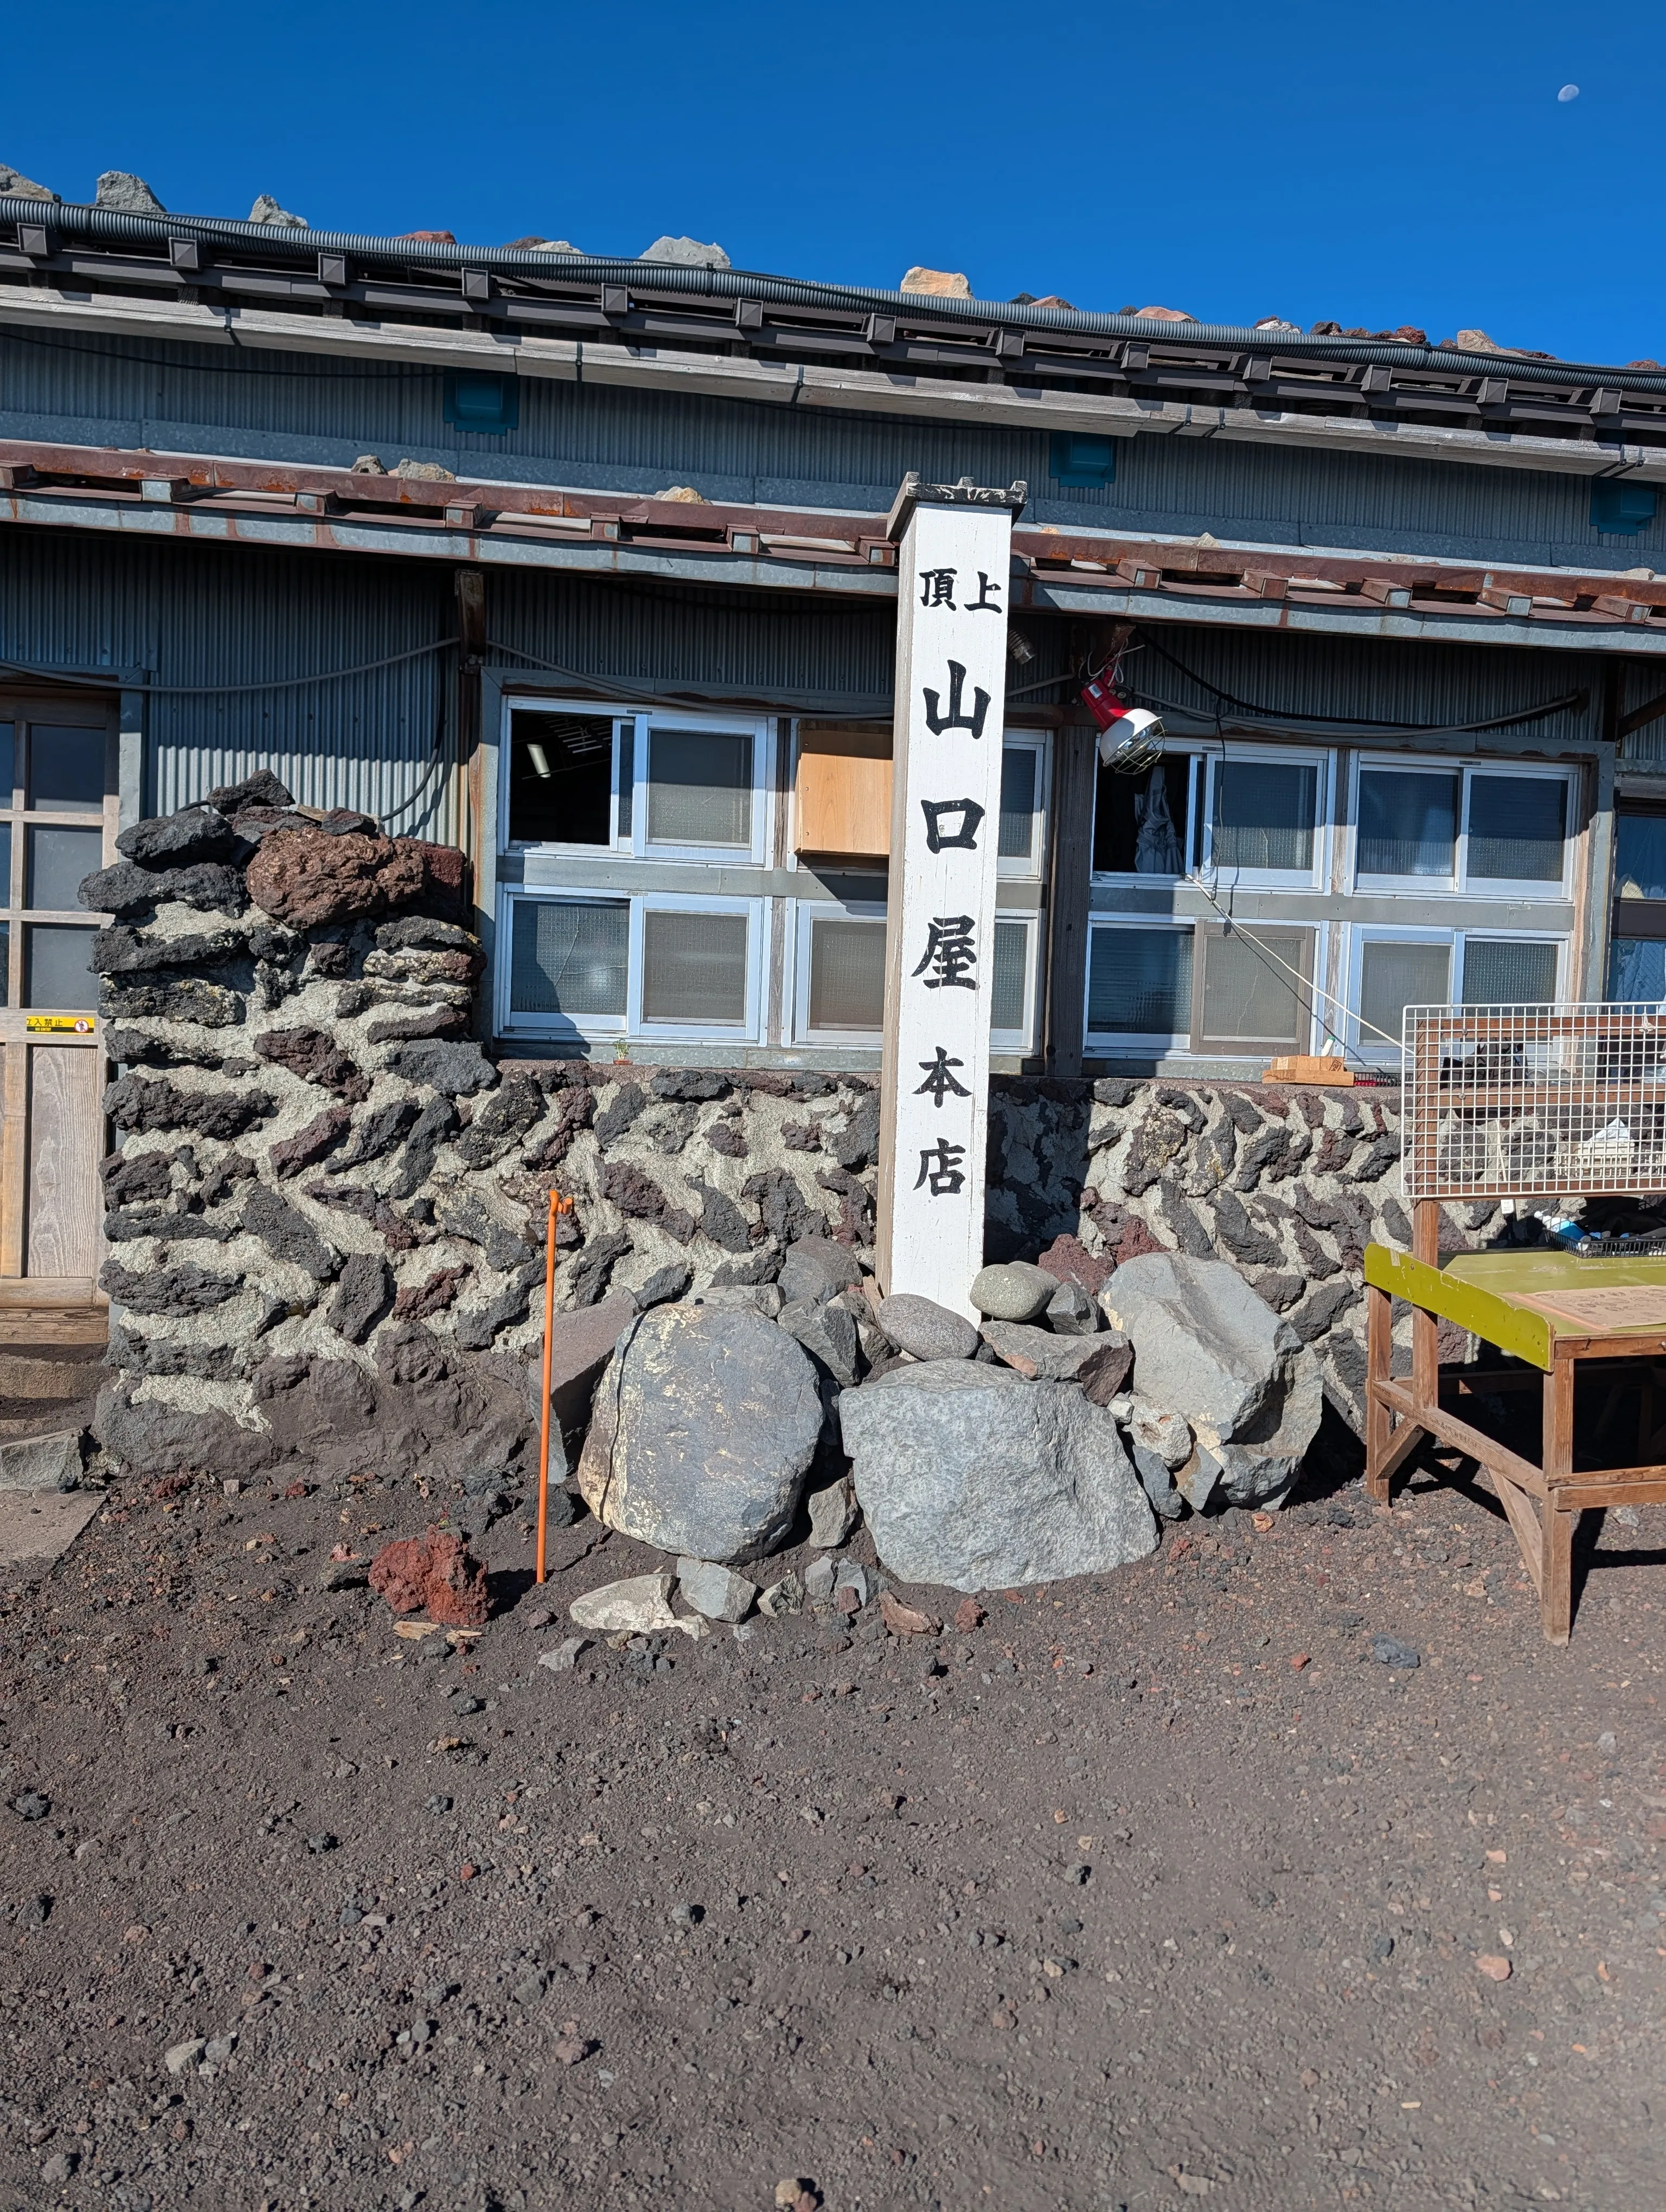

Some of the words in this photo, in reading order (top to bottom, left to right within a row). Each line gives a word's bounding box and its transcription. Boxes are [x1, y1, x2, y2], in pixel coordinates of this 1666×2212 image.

[919, 567, 1003, 614] 頂上
[911, 659, 991, 1197] 山口屋本店
